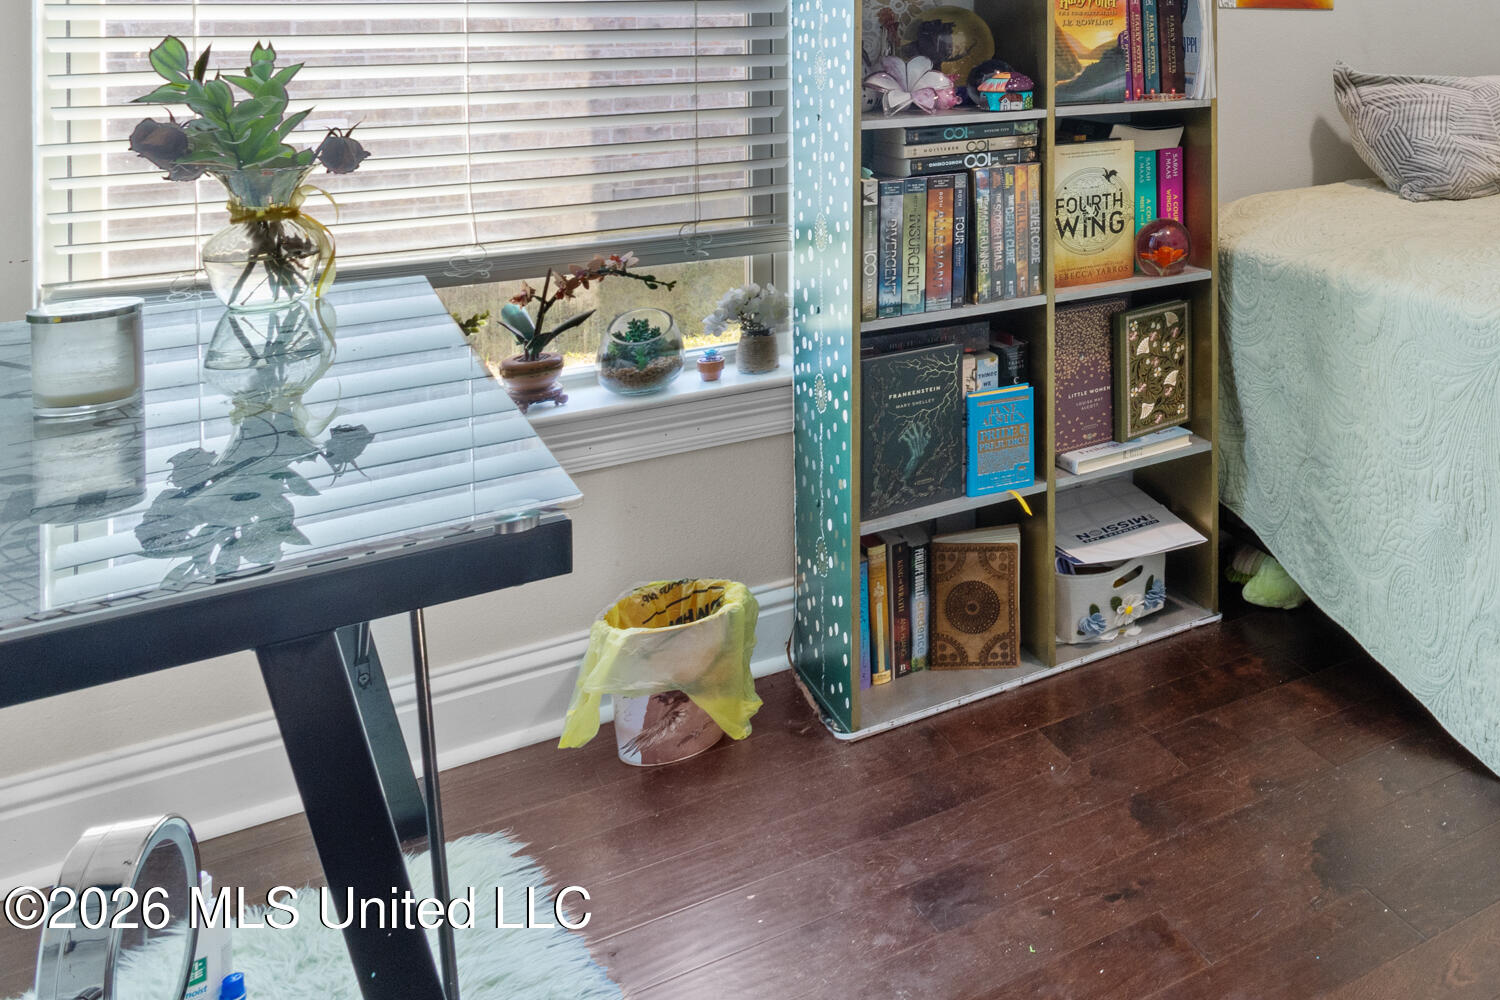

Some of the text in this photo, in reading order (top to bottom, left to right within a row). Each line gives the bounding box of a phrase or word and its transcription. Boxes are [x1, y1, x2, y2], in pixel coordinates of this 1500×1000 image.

[1076, 18, 1114, 27] ROWLING
[944, 127, 968, 140] 100
[964, 153, 991, 168] 100
[1056, 192, 1123, 216] FOURTH
[955, 216, 965, 245] FOUR
[992, 204, 1001, 238] SCORCH
[1005, 207, 1014, 237] DEATH
[1056, 211, 1125, 239] WING
[864, 249, 877, 276] 100
[884, 218, 897, 295] DIVERGENT
[907, 213, 921, 296] INSURGENT
[932, 209, 945, 289] ALLEGIANT
[979, 236, 989, 275] RUNNER
[993, 240, 1003, 271] TRIALS
[1005, 238, 1015, 264] CURE
[1031, 235, 1040, 264] CODE
[1096, 265, 1128, 276] YARROS
[889, 386, 941, 400] FRANKENSTEIN
[912, 398, 935, 406] SHELLEY
[1068, 391, 1088, 400] LITTLE
[914, 548, 925, 576] PENELOPE
[897, 585, 905, 612] WRATH
[917, 601, 925, 654] credence
